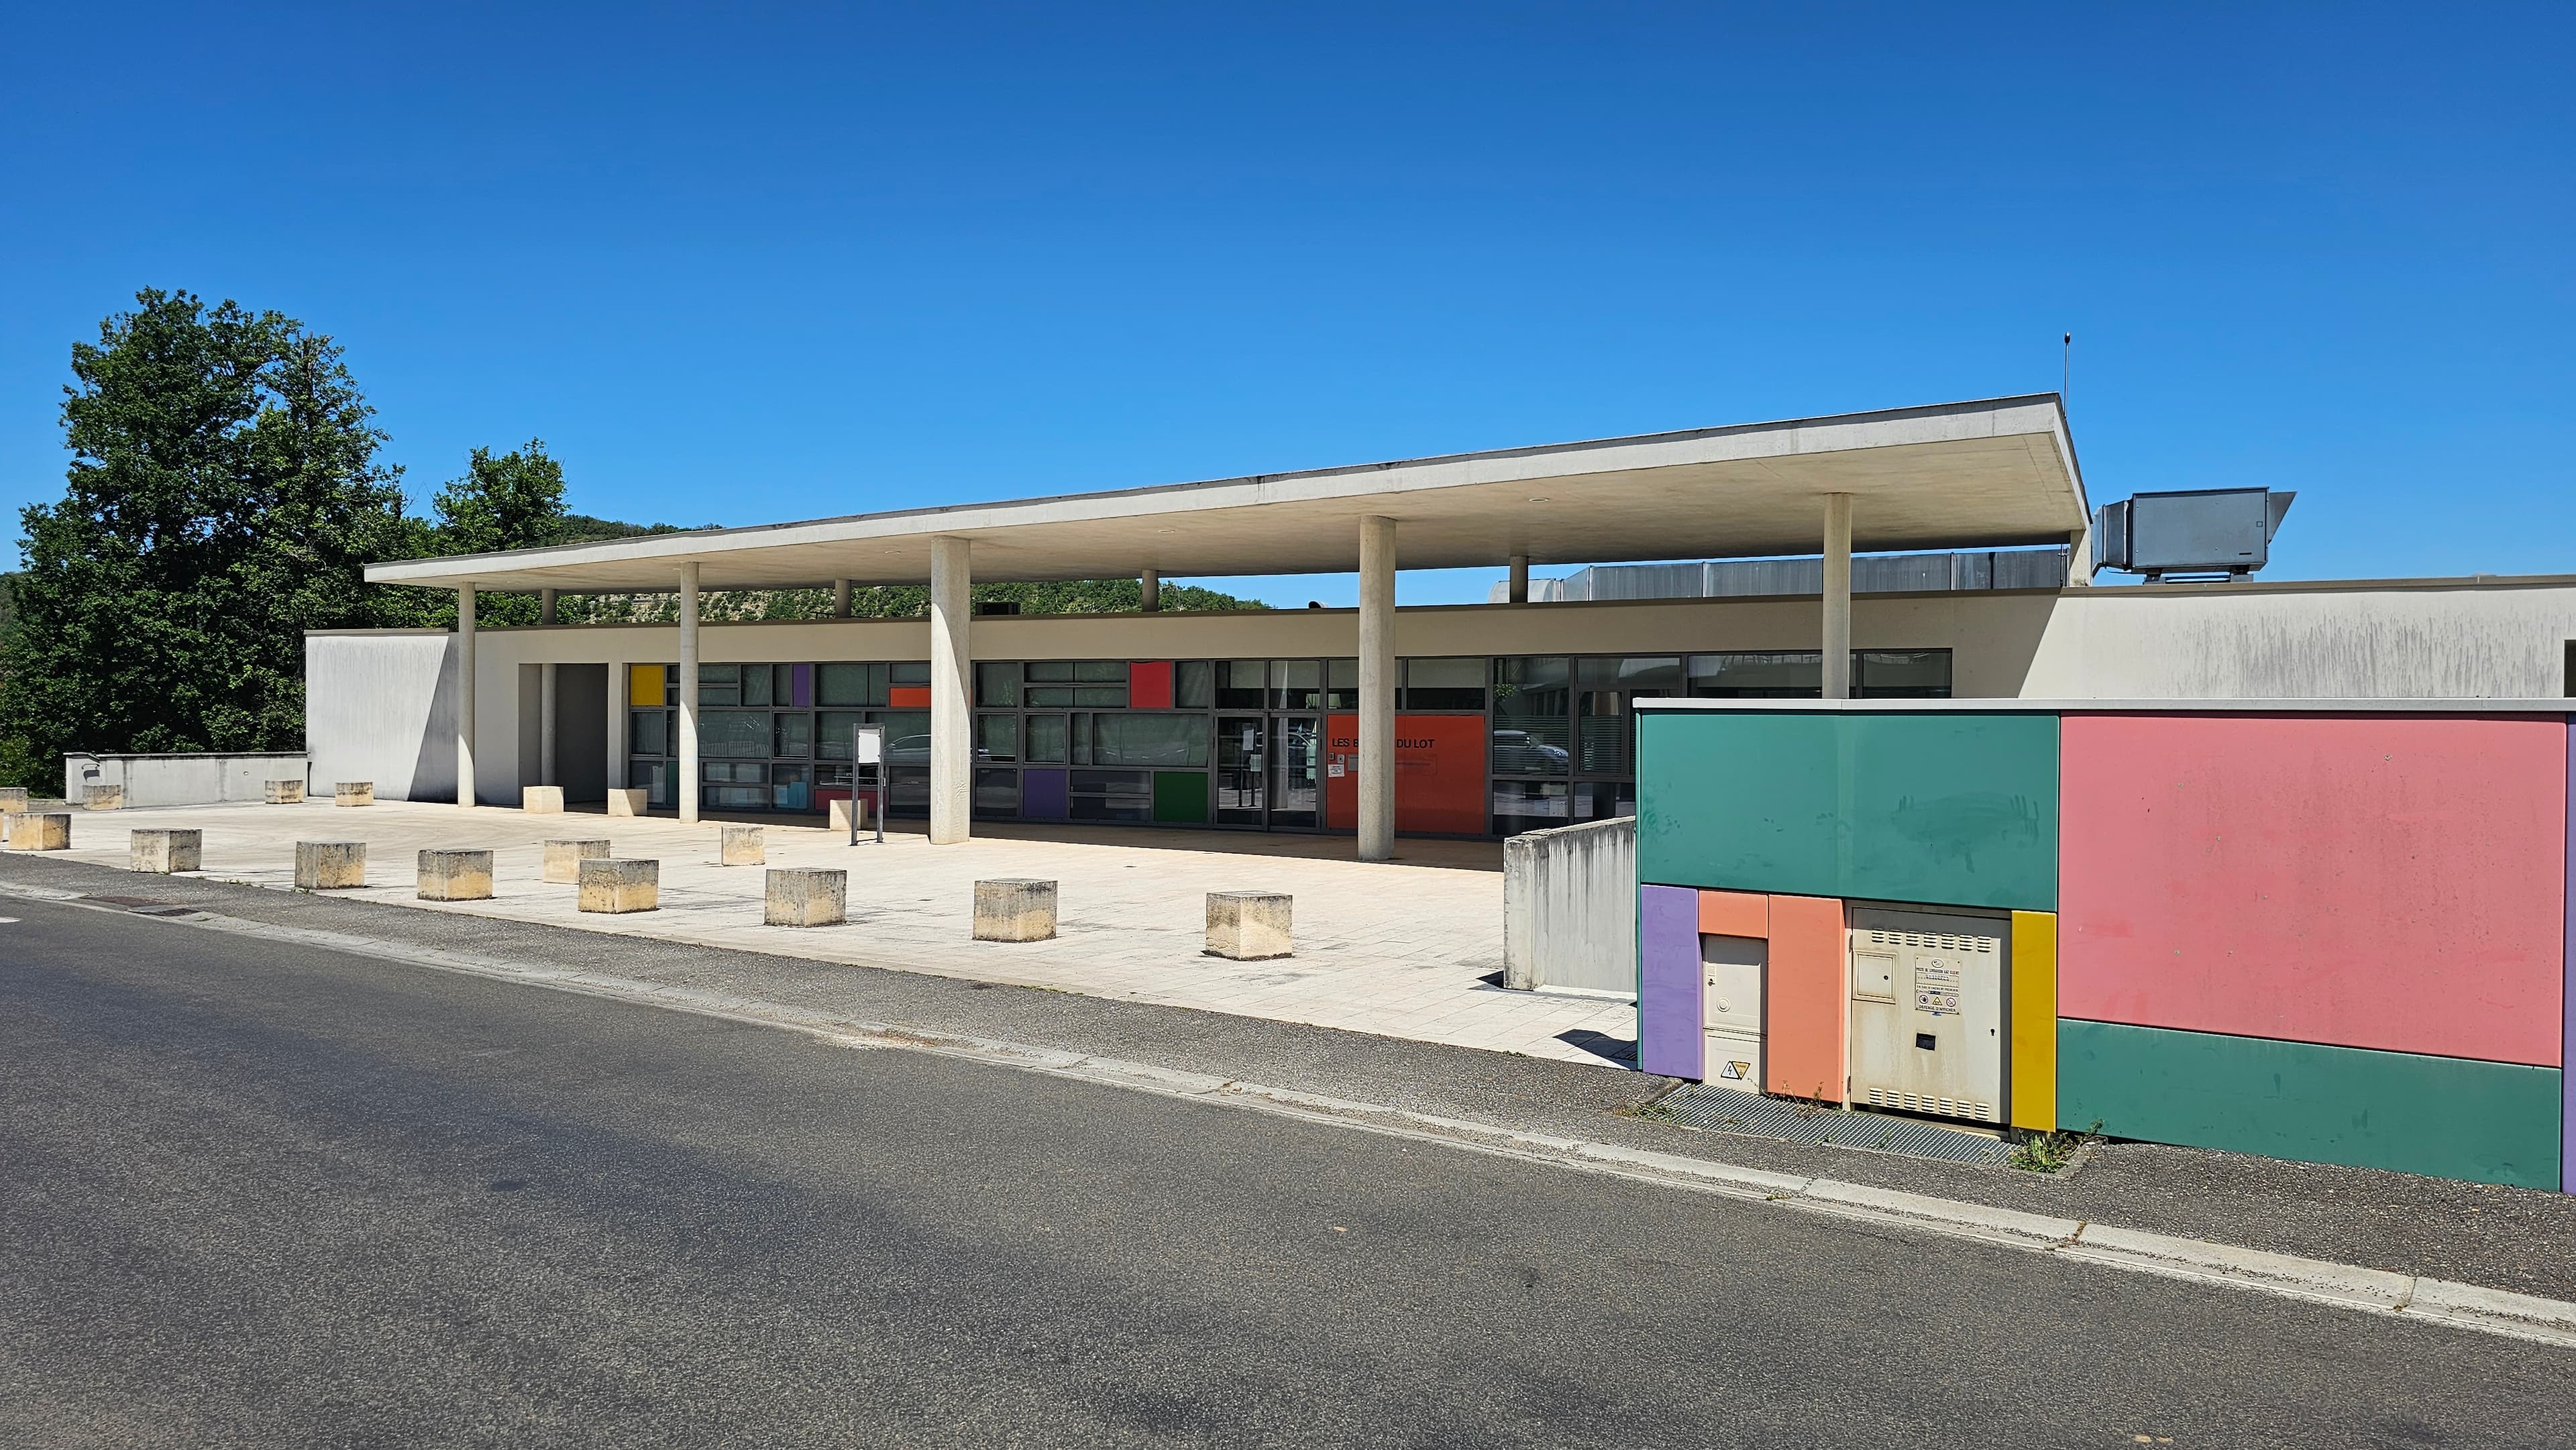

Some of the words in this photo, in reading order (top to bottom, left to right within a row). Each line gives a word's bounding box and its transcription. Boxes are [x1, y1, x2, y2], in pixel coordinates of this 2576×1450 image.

[1332, 738, 1350, 747] LES
[1397, 739, 1411, 748] DU
[1413, 739, 1435, 748] LOT
